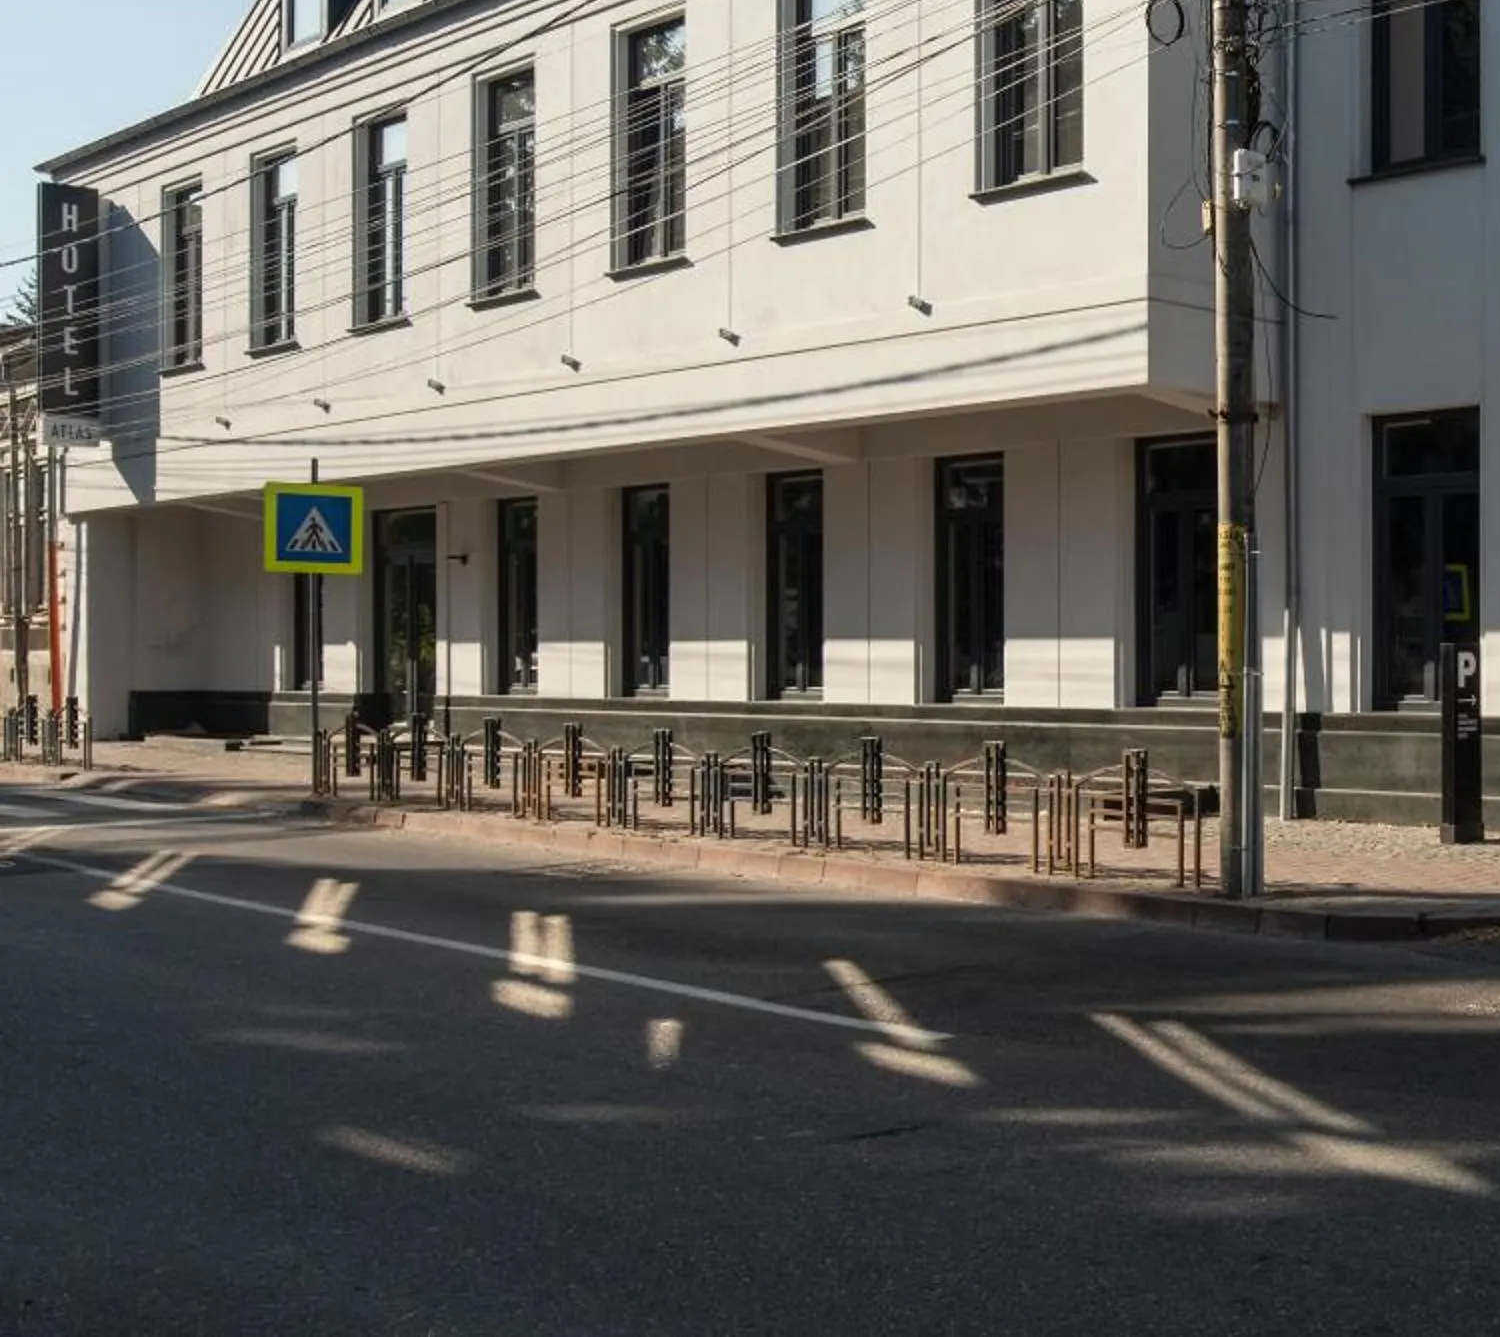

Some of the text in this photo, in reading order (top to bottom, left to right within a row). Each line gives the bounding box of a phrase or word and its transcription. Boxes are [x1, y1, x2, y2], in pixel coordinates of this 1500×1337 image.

[62, 203, 79, 396] HOTEL
[51, 423, 93, 440] ATLAS
[1457, 651, 1477, 688] P
